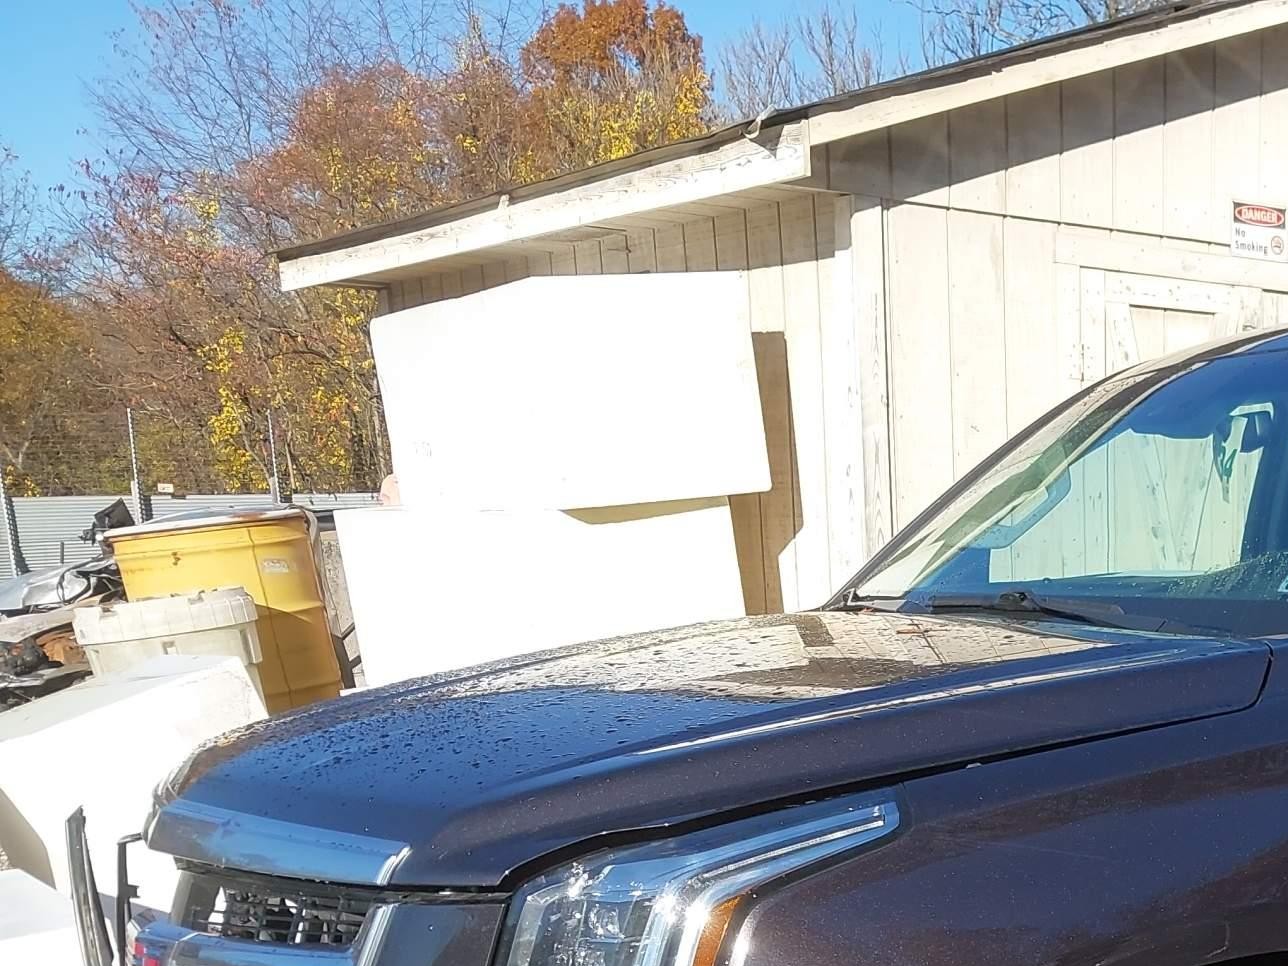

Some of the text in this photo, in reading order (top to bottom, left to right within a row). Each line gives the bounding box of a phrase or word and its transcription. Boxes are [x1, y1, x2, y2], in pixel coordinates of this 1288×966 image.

[1241, 207, 1278, 224] DANGER
[1235, 227, 1246, 237] No
[1235, 240, 1268, 256] Smoking
